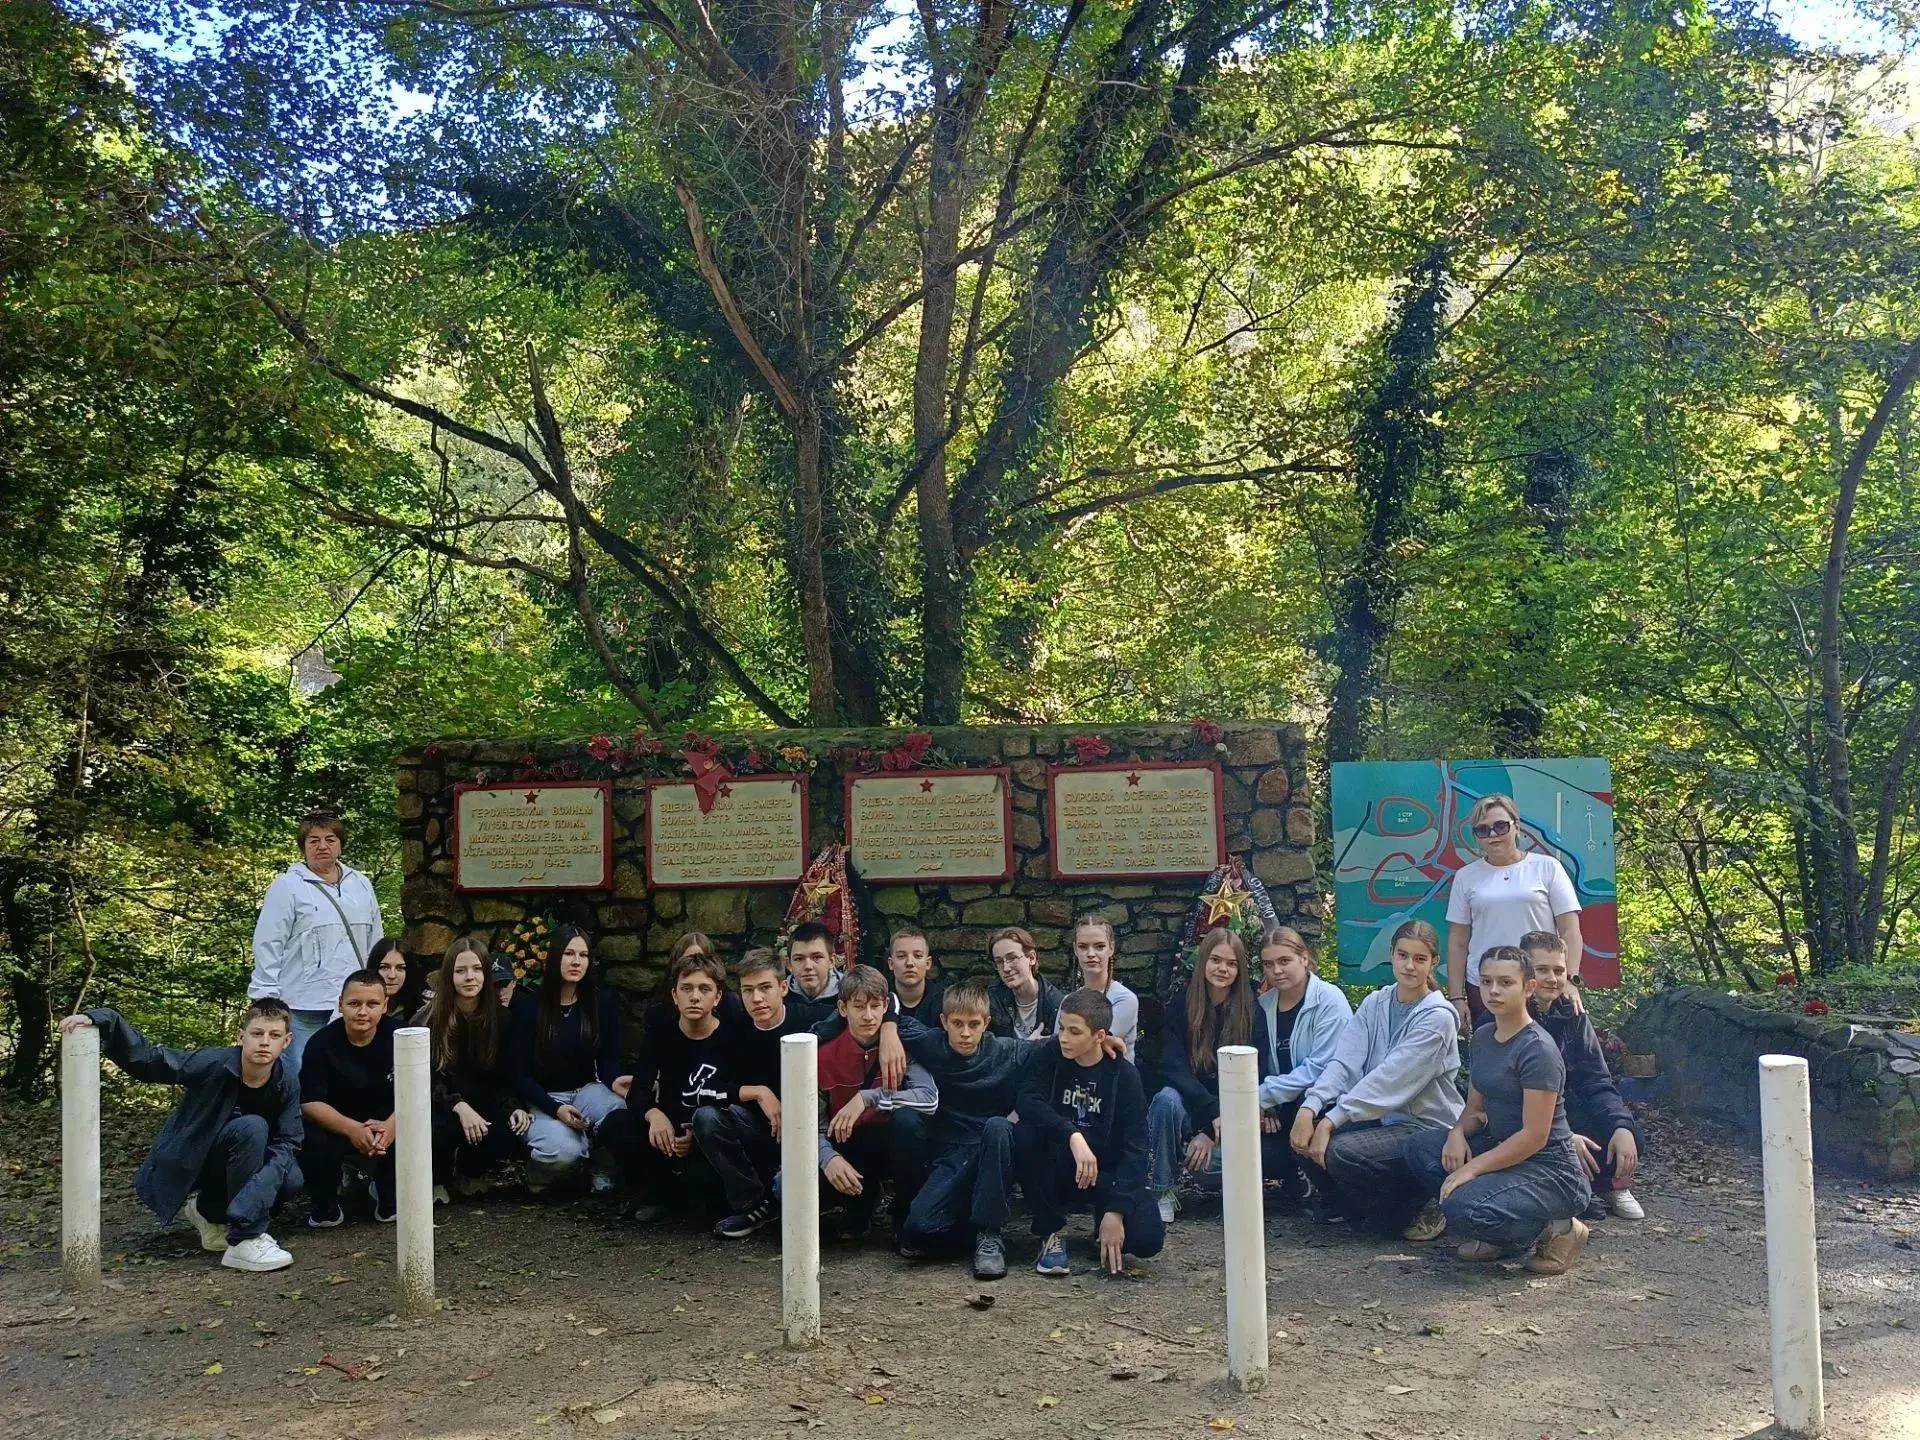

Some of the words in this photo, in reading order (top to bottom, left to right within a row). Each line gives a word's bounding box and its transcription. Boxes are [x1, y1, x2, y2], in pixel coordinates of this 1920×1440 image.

[861, 798, 893, 807] ЗДЕСЬ
[899, 795, 936, 806] СТОЯЛИ
[939, 794, 994, 804] НАСМЕРТЬ
[1065, 789, 1113, 803] СУРОВОЙ
[1124, 790, 1169, 801] ОСЕНЬЮ
[472, 807, 543, 818] ГЕРОИЧЕСКИМ
[552, 806, 592, 815] ВОИНАМ
[660, 803, 693, 813] ЗДЕСЬ
[739, 799, 792, 809] НАСМЕРТЬ
[1063, 806, 1098, 817] ЗДЕСЬ
[1105, 804, 1143, 815] СТОЯЛИ
[1151, 802, 1208, 813] НАСМЕРТЬ
[660, 816, 695, 826] ВОИНЫ
[737, 813, 792, 823] БАТАЛЬОНА
[861, 811, 895, 820] ВОИНЫ
[939, 807, 994, 818] БАТАЛЬОНА
[1066, 819, 1102, 829] ВОИНЫ
[1150, 816, 1208, 827] БАТАЛЬОНА
[735, 839, 773, 849] ОСЕНЬЮ
[936, 834, 975, 844] ОСЕНЬЮ
[542, 847, 570, 857] ЗДЕСЬ
[864, 850, 902, 860] ВЕЧНАЯ
[909, 849, 943, 859] СЛАВА
[491, 859, 533, 869] ОСЕНЬЮ
[662, 853, 737, 865] БЛАГОДАРНЫЕ
[1075, 858, 1115, 869] ВЕЧНАЯ
[1125, 856, 1157, 867] СЛАВА
[681, 868, 700, 877] ВАС
[708, 867, 721, 876] НЕ
[730, 866, 775, 877] ЗАБУДУТ
[1062, 1089, 1102, 1113] BLCK
